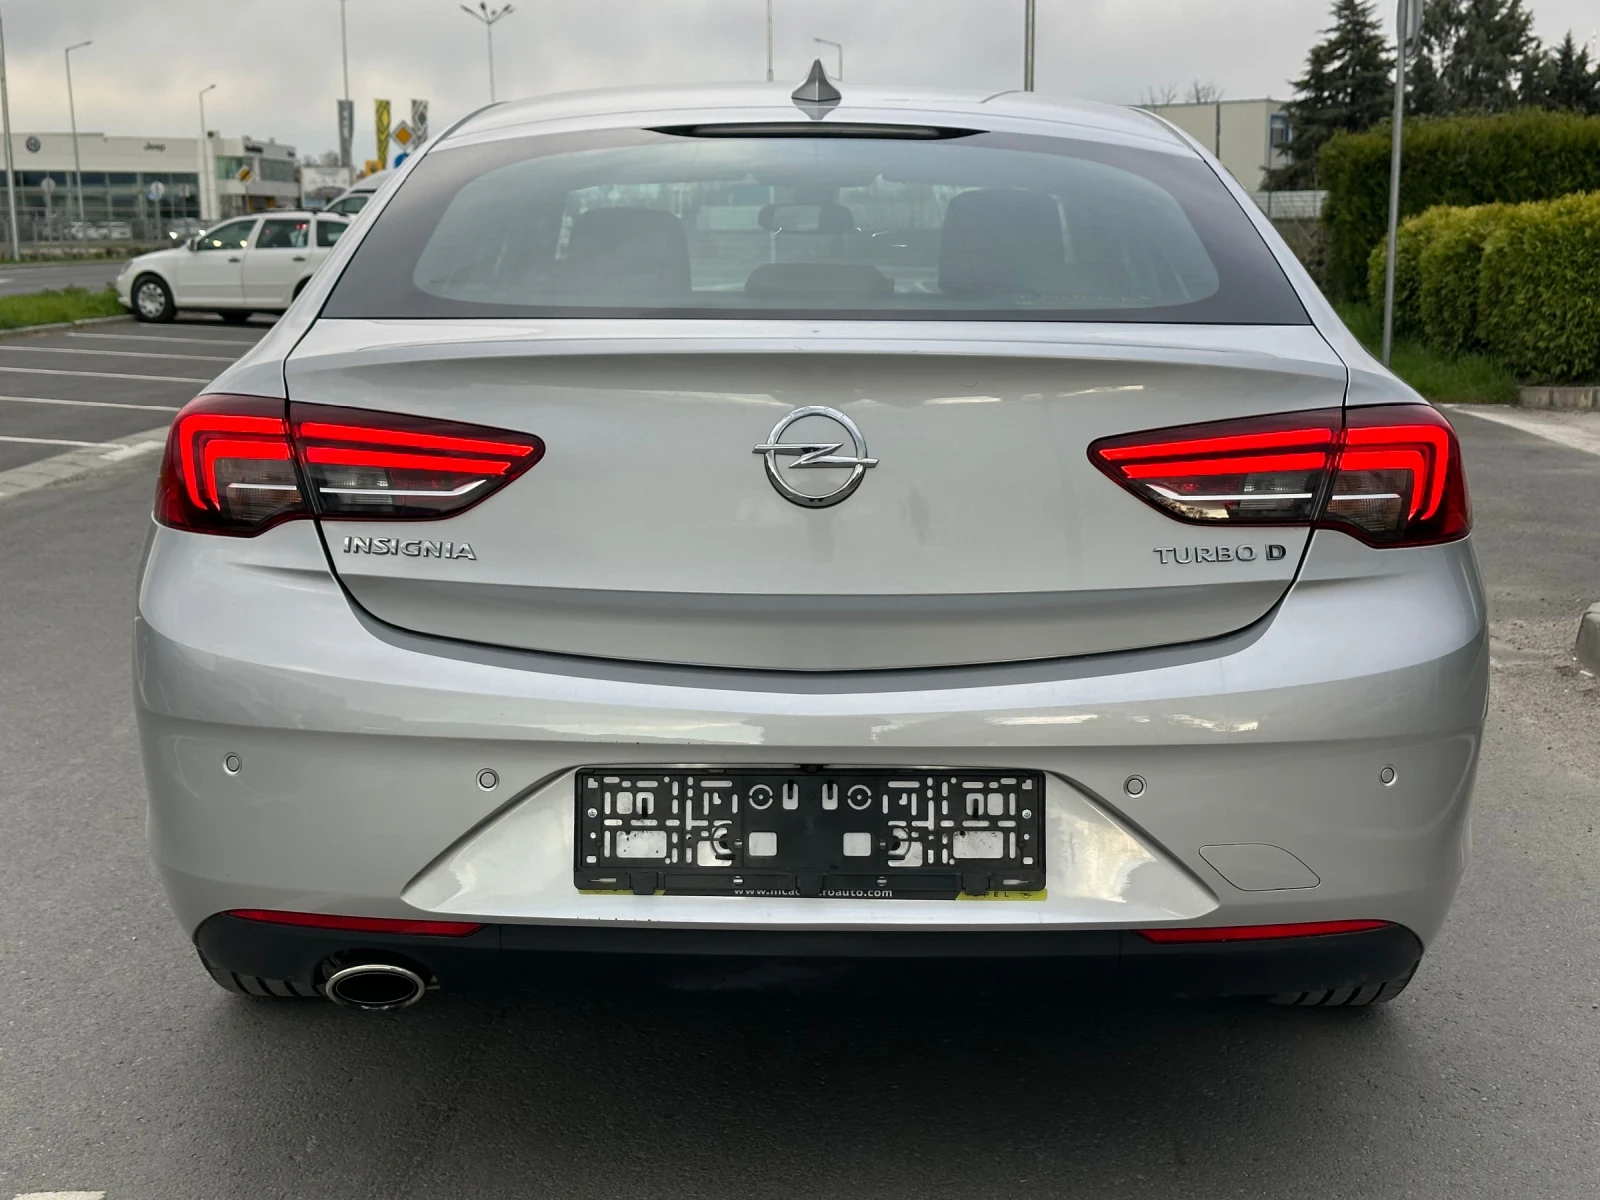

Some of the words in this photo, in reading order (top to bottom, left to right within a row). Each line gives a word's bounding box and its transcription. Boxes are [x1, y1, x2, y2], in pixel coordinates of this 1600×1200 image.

[143, 141, 166, 152] Jeep
[343, 536, 477, 560] INSIGNIA
[1153, 544, 1258, 565] TURBO
[1265, 544, 1287, 561] D
